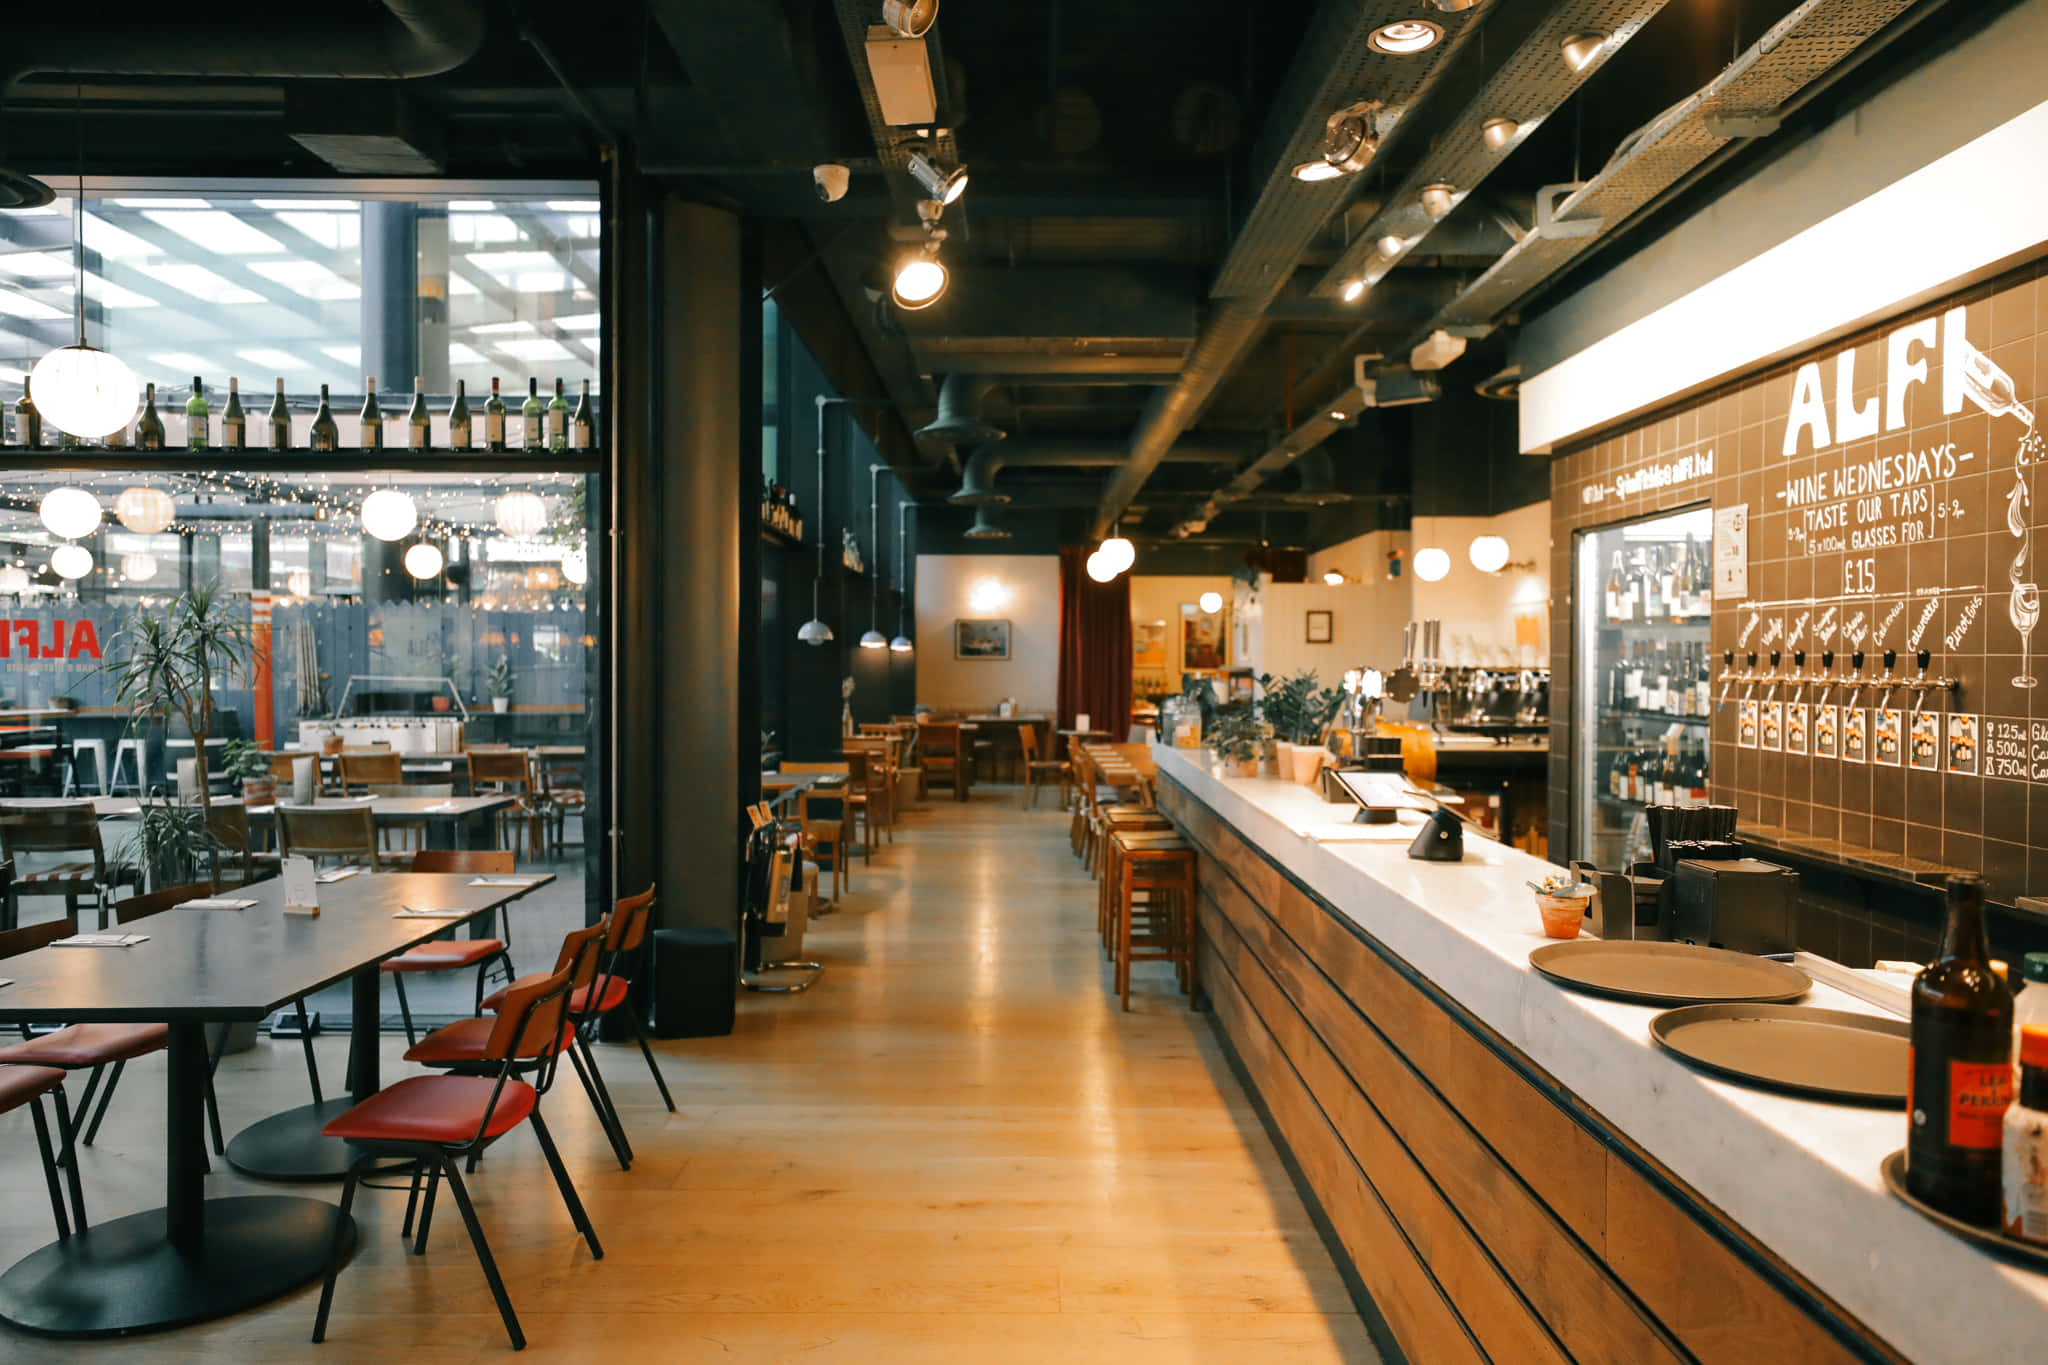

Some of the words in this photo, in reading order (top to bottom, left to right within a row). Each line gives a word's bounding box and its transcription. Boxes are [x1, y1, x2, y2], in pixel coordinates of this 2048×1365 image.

[1782, 305, 1966, 457] ALFI
[1833, 443, 1957, 498] WEDNESDAYS
[1806, 503, 1848, 531] TASTE
[1857, 496, 1883, 524] OUR
[1890, 487, 1928, 517] TAPS
[1851, 525, 1896, 549] GLASSES
[1902, 520, 1924, 543] FOR
[1845, 558, 1875, 593] £15
[1996, 740, 2027, 759] 500ml
[1995, 758, 2027, 777] 750ml
